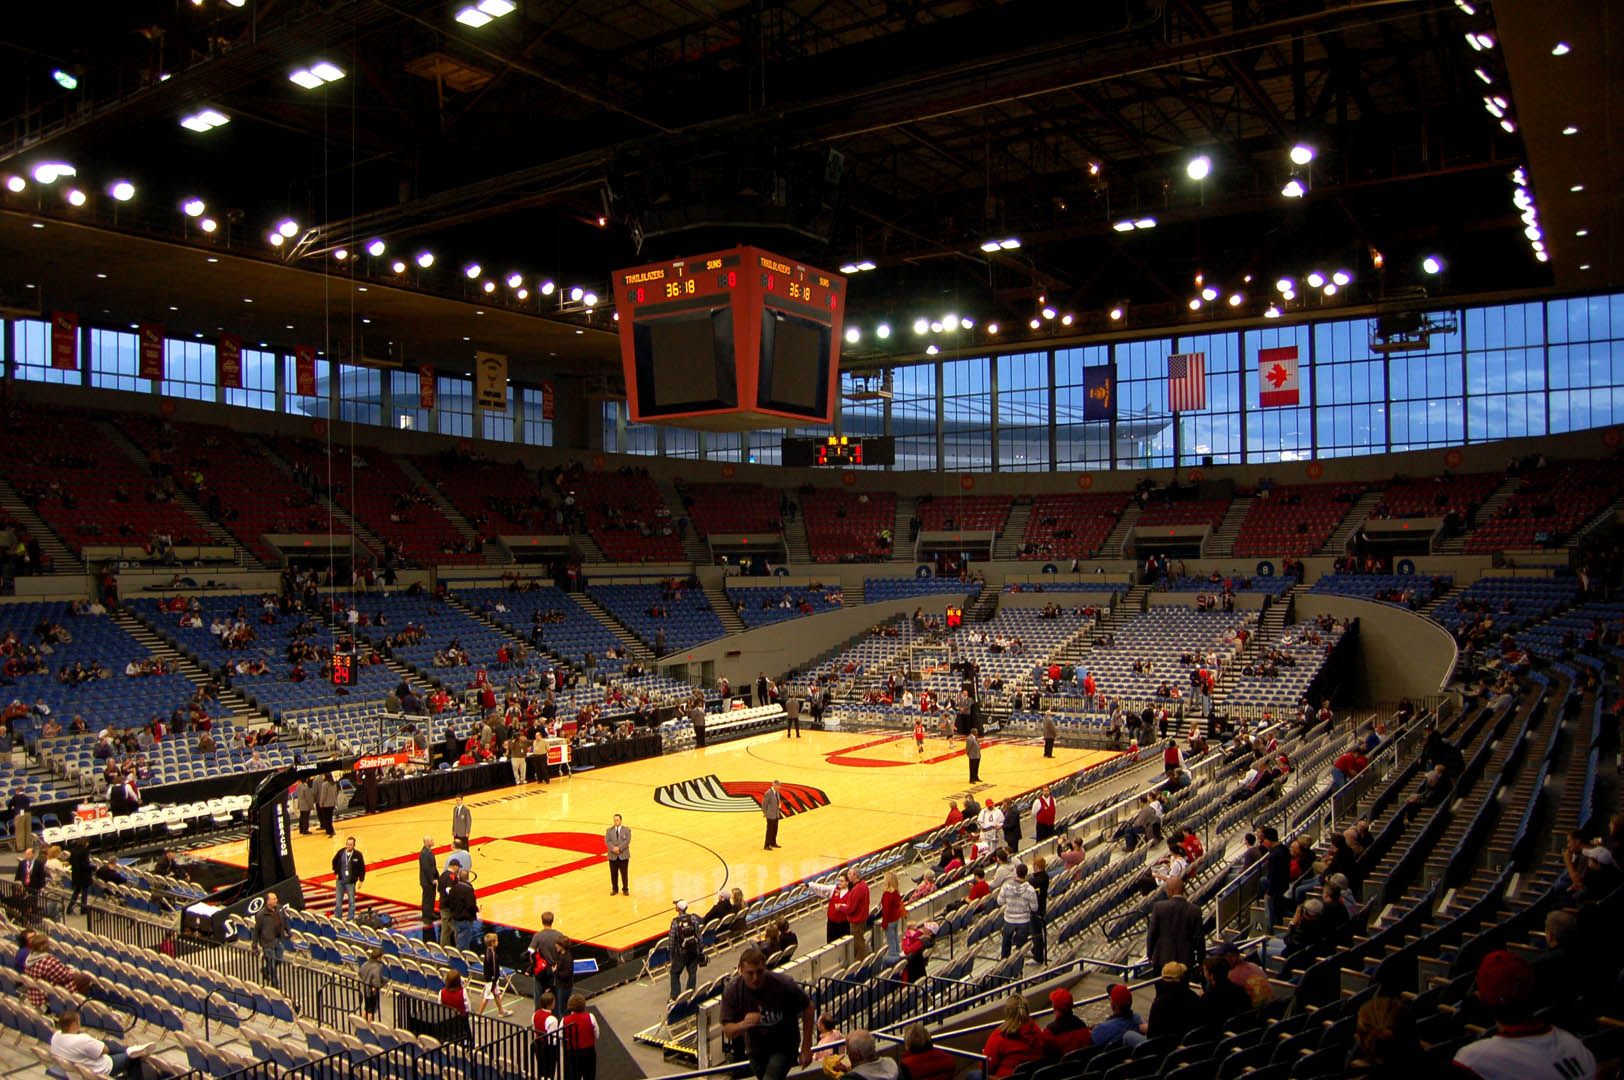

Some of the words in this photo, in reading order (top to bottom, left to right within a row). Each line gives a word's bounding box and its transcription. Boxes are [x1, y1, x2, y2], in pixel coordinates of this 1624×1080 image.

[706, 258, 722, 270] SUNS
[625, 269, 665, 285] TRAILBLAZERS
[728, 271, 737, 287] 0
[637, 287, 645, 303] 0
[666, 279, 695, 298] 36:18
[789, 281, 811, 301] 36:18
[334, 665, 349, 683] 24
